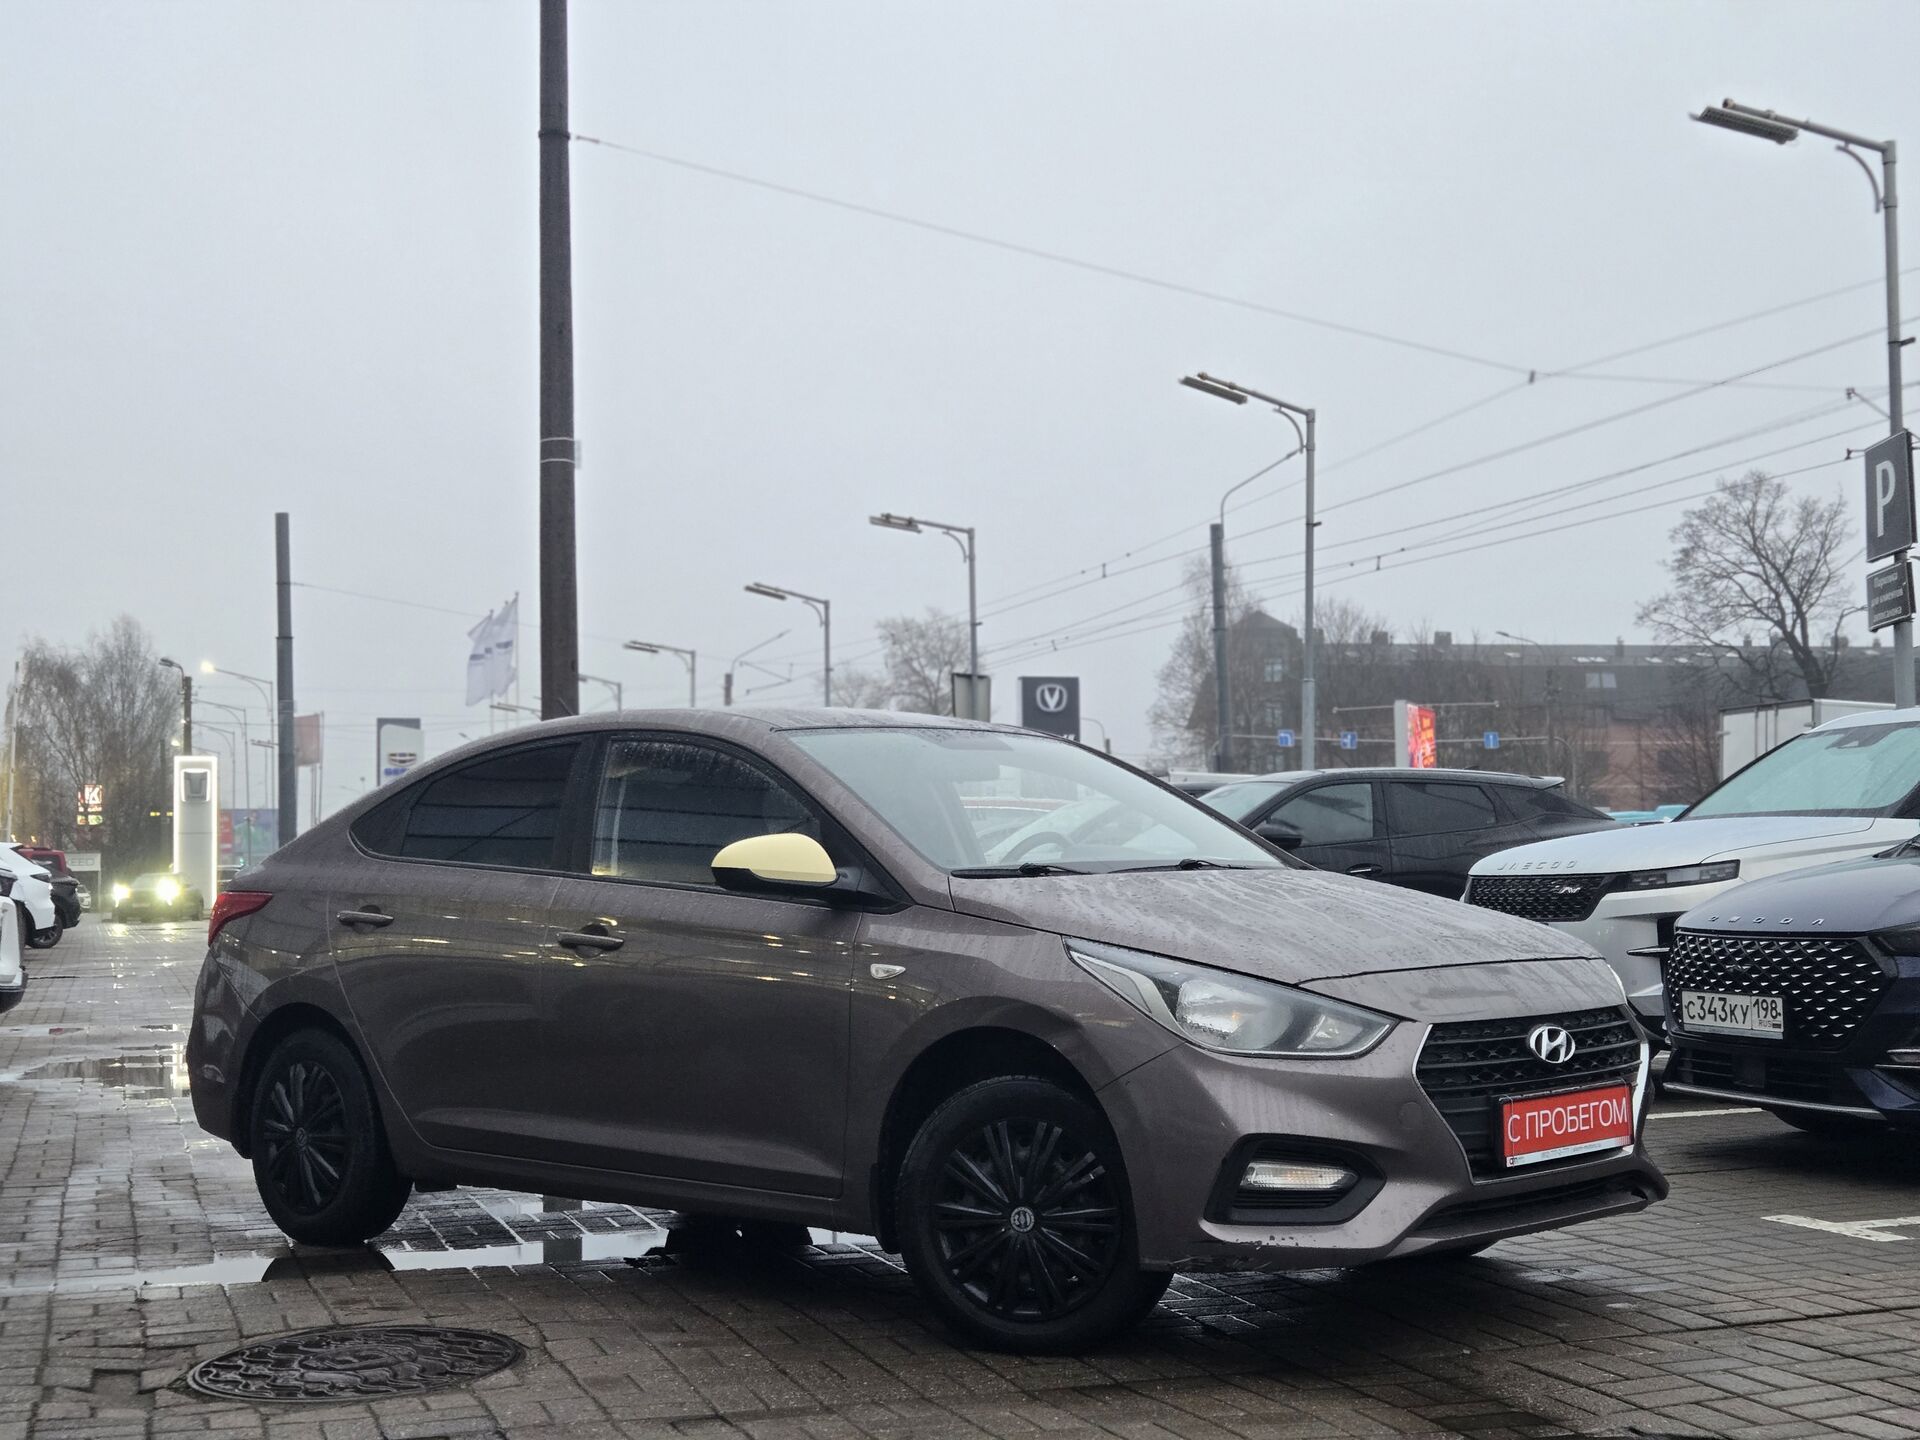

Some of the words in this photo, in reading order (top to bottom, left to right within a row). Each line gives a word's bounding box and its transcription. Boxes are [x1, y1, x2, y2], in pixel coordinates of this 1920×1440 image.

[1875, 460, 1896, 538] P
[1753, 998, 1777, 1020] 198
[1758, 1019, 1772, 1028] RUS
[1507, 1114, 1521, 1142] С
[1525, 1097, 1628, 1140] ПРОБЕГОМ
